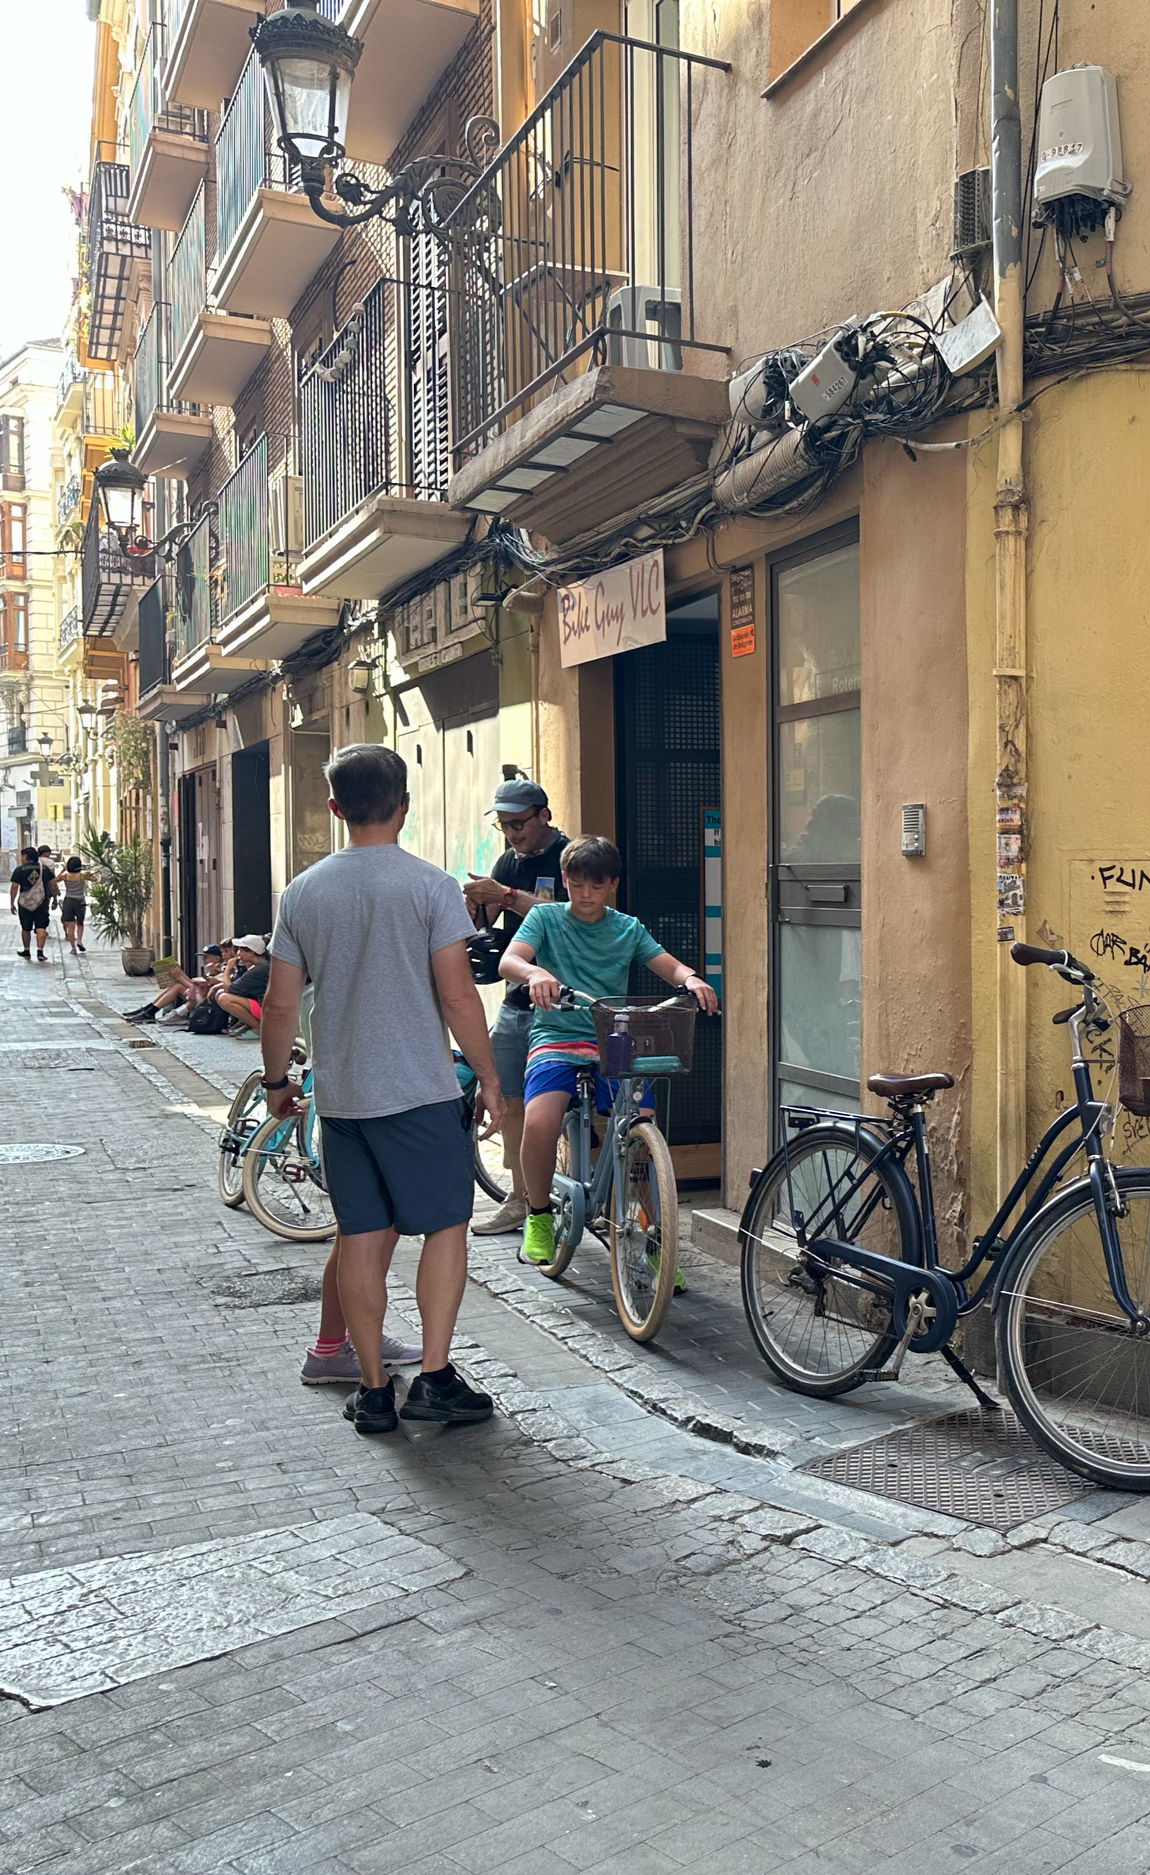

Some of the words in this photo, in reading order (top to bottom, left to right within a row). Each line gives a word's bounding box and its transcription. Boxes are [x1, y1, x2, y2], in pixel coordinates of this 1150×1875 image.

[560, 592, 591, 645] Bike
[595, 580, 626, 646] Guy
[629, 558, 662, 620] VLC
